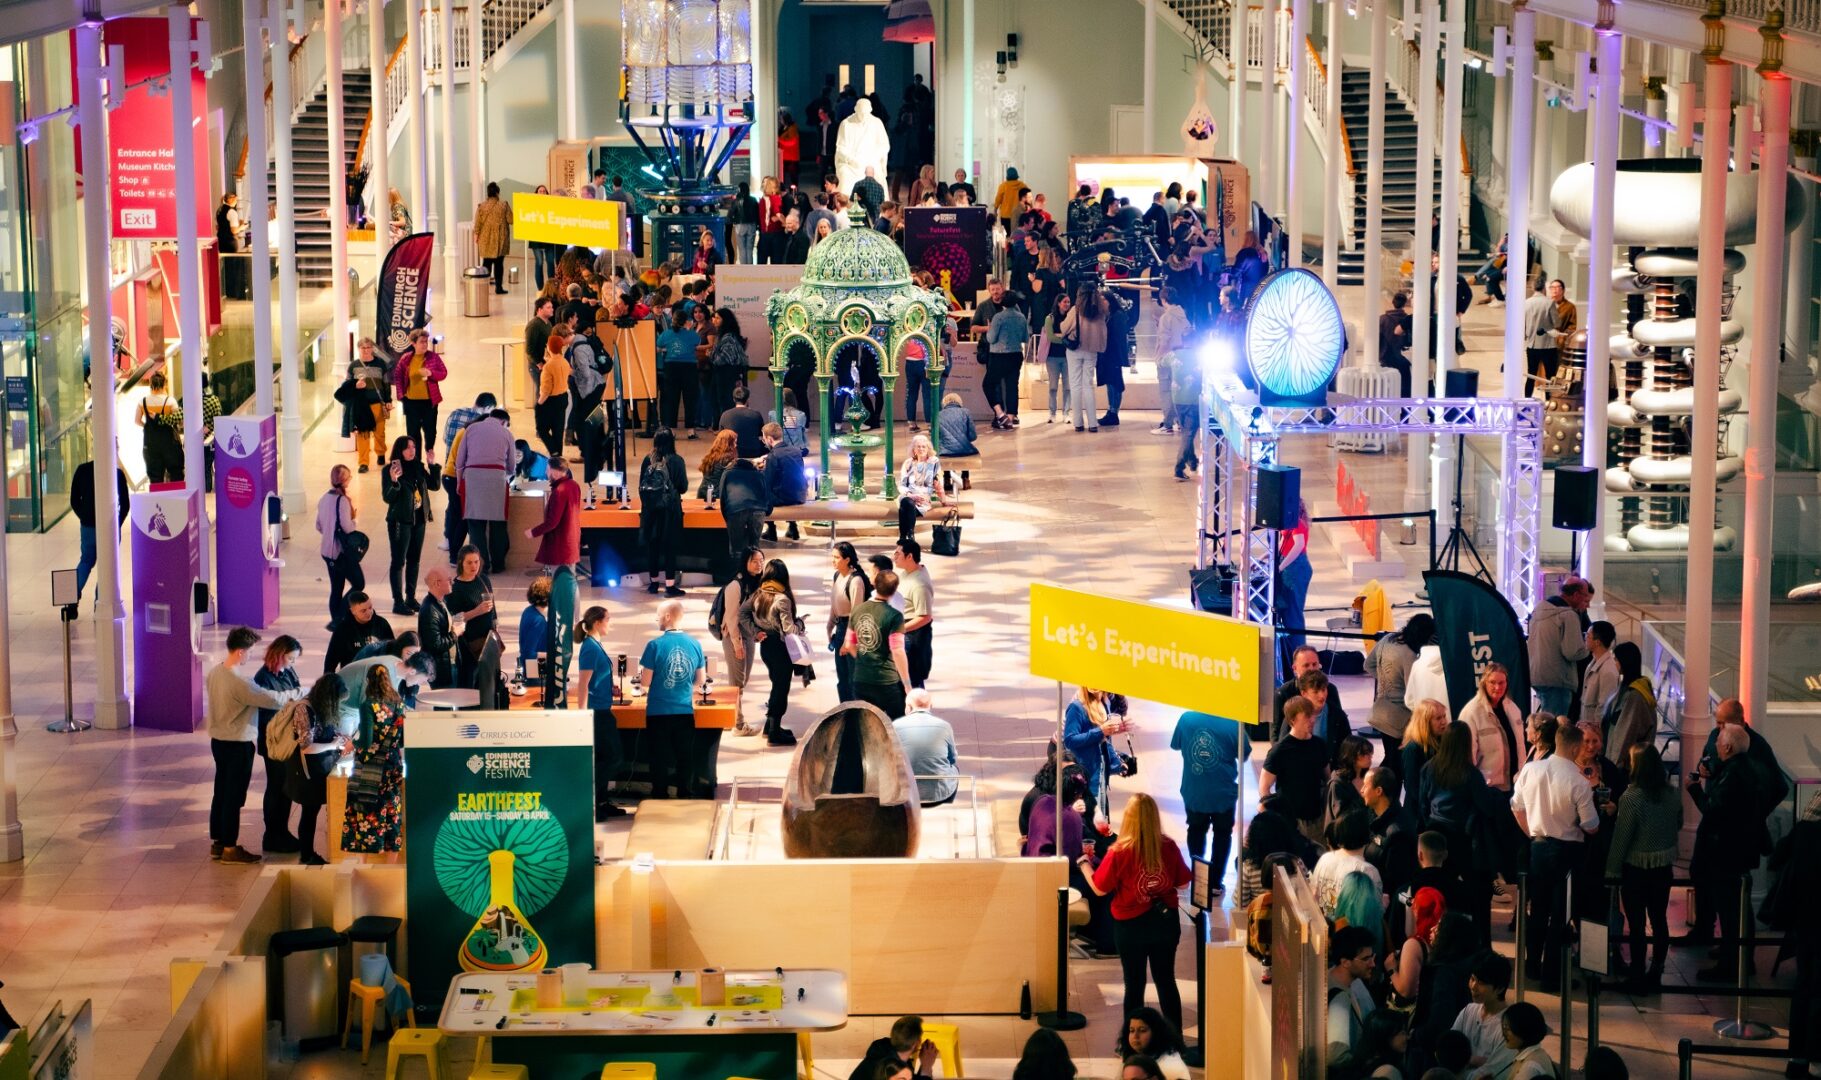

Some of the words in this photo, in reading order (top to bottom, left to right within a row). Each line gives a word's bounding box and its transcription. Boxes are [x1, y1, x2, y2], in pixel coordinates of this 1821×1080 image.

[117, 148, 157, 158] Entrance
[158, 148, 174, 158] Hal
[118, 163, 152, 171] Museum
[118, 176, 139, 186] Shop
[119, 189, 145, 198] Toilets
[124, 212, 152, 226] Exit
[519, 208, 545, 224] Let's
[547, 210, 611, 231] Experiment
[392, 267, 407, 327] EDINBURGH
[402, 268, 419, 328] SCIENCE
[1042, 615, 1098, 651] Let's
[1104, 627, 1241, 682] Experiment
[480, 731, 507, 739] CIRRUS
[510, 730, 535, 739] LOGIC
[484, 752, 531, 760] EDINBURGH
[484, 759, 531, 769] SCIENCE
[484, 768, 532, 779] FESTIVAL
[457, 792, 542, 811] EARTHFEST
[449, 811, 483, 821] SATURDAY
[530, 810, 550, 820] APRIL
